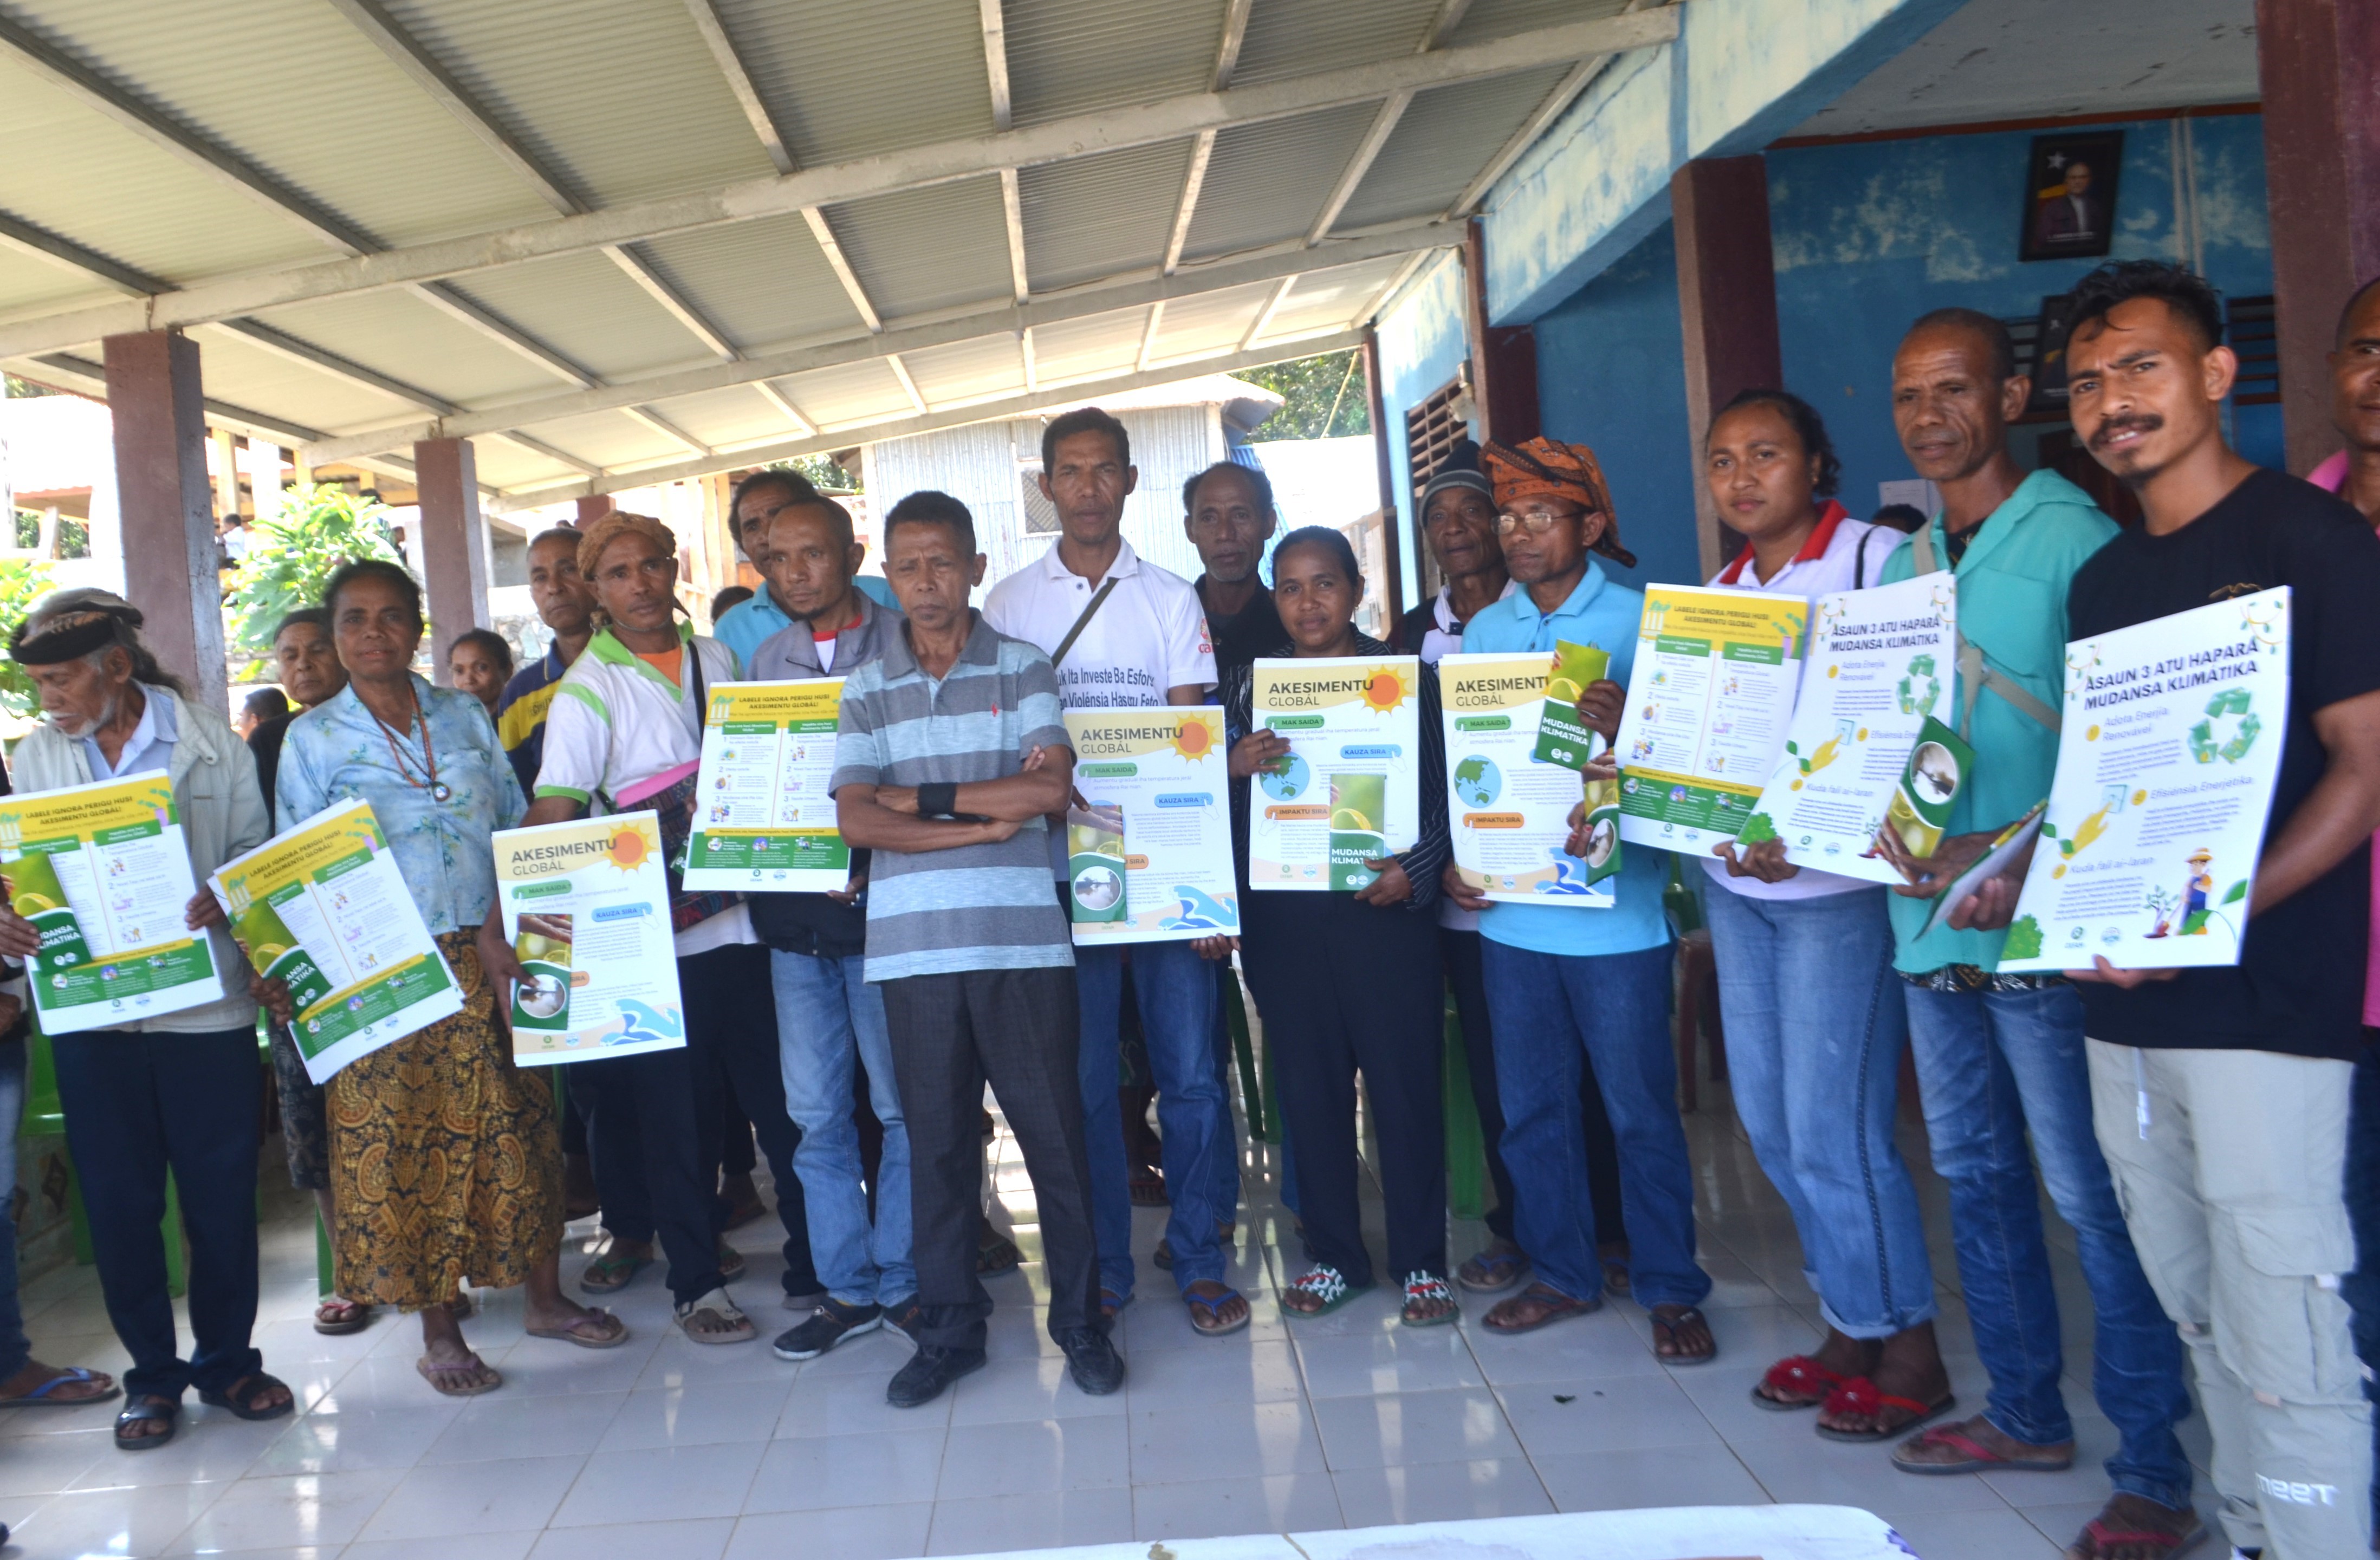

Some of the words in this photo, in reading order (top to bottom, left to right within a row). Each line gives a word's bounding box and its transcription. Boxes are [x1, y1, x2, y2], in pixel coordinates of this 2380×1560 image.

[1831, 623, 1867, 636] ASAUN
[1871, 625, 1876, 634] 3
[1878, 622, 1897, 633] ATU
[1198, 644, 1211, 653] ca
[1829, 638, 1883, 652] MUDANSA
[1068, 668, 1078, 684] Ita
[1081, 667, 1112, 684] Investe
[1113, 667, 1124, 683] Ba
[2085, 668, 2137, 692] ASAUN
[2141, 666, 2150, 678] 3
[2154, 656, 2183, 675] ATU
[1269, 679, 1374, 694] AKESIMENTU
[1068, 691, 1109, 707] Violénsia
[1141, 693, 1158, 706] Feto
[1269, 694, 1320, 706] GLOBÁL
[1456, 693, 1505, 706] GLOBÁL
[2084, 681, 2163, 710] MUDANSA
[2104, 714, 2132, 727] Adota
[2136, 707, 2168, 722] Enerjia
[1080, 727, 1183, 741] AKESIMENTU
[1542, 717, 1587, 736] MUDANSA
[1541, 725, 1588, 745] KLIMATIKA
[1081, 741, 1132, 754] GLOBÁL
[52, 805, 82, 815] IGNORA
[85, 800, 112, 810] PERIGU
[40, 812, 88, 825] AKESIMENTU
[249, 862, 271, 877] LABELE
[272, 849, 299, 865] IGNORA
[299, 838, 323, 852] PERIGU
[325, 830, 341, 841] HUSI
[511, 838, 617, 863] AKESIMENTU
[263, 856, 304, 880] AKESIMENTU
[512, 859, 565, 876] GLOBÁL
[596, 909, 620, 918] KAUZA
[40, 925, 75, 939] DANSA
[36, 932, 82, 949] LIMATIKA
[286, 962, 308, 980] ANSA
